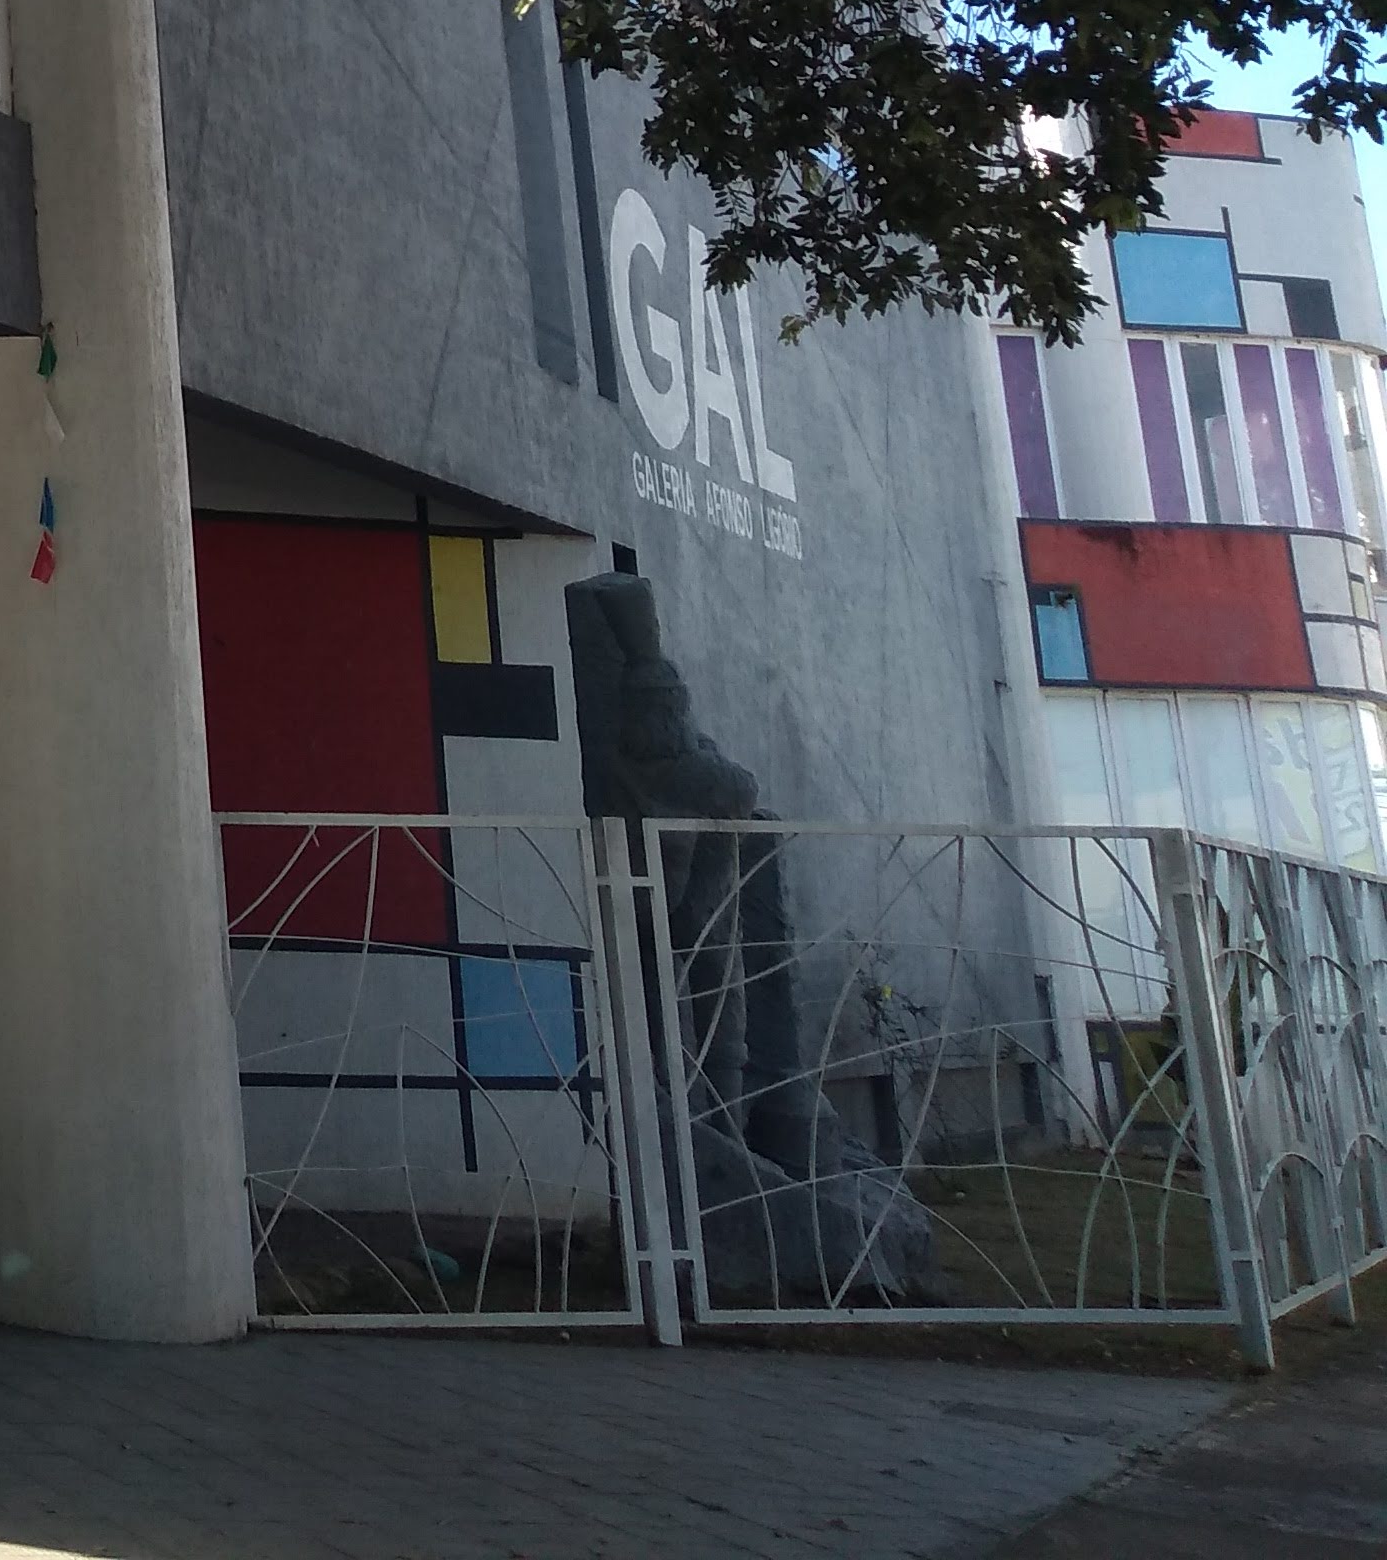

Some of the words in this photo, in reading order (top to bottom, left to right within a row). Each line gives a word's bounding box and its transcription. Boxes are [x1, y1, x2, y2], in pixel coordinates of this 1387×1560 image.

[610, 188, 797, 503] GAL
[632, 451, 697, 518] GALERIA
[705, 480, 753, 540] AFONSO
